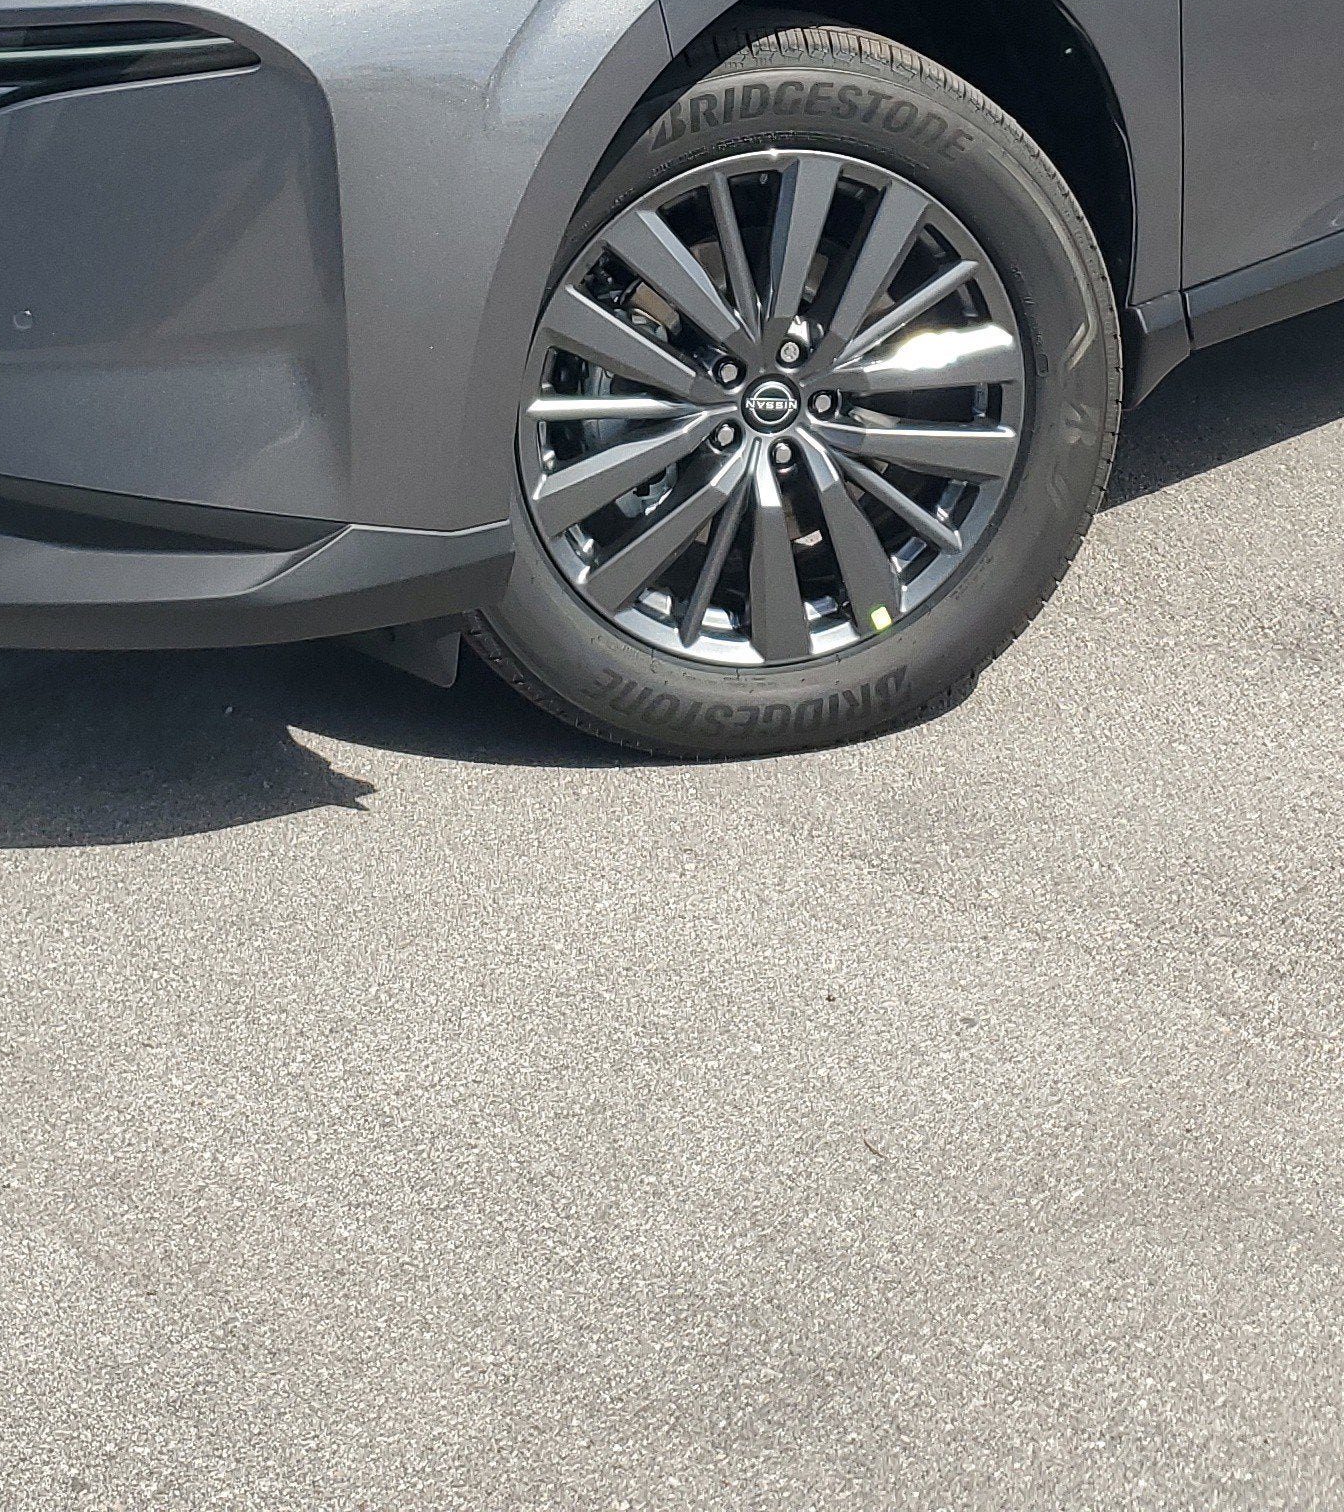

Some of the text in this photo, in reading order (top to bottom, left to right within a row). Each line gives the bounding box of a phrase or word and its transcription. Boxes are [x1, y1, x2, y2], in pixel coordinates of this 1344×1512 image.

[650, 81, 974, 160] BRIDGESTONE
[746, 399, 797, 409] NISSAN
[582, 665, 906, 734] BRIDGESTONE
